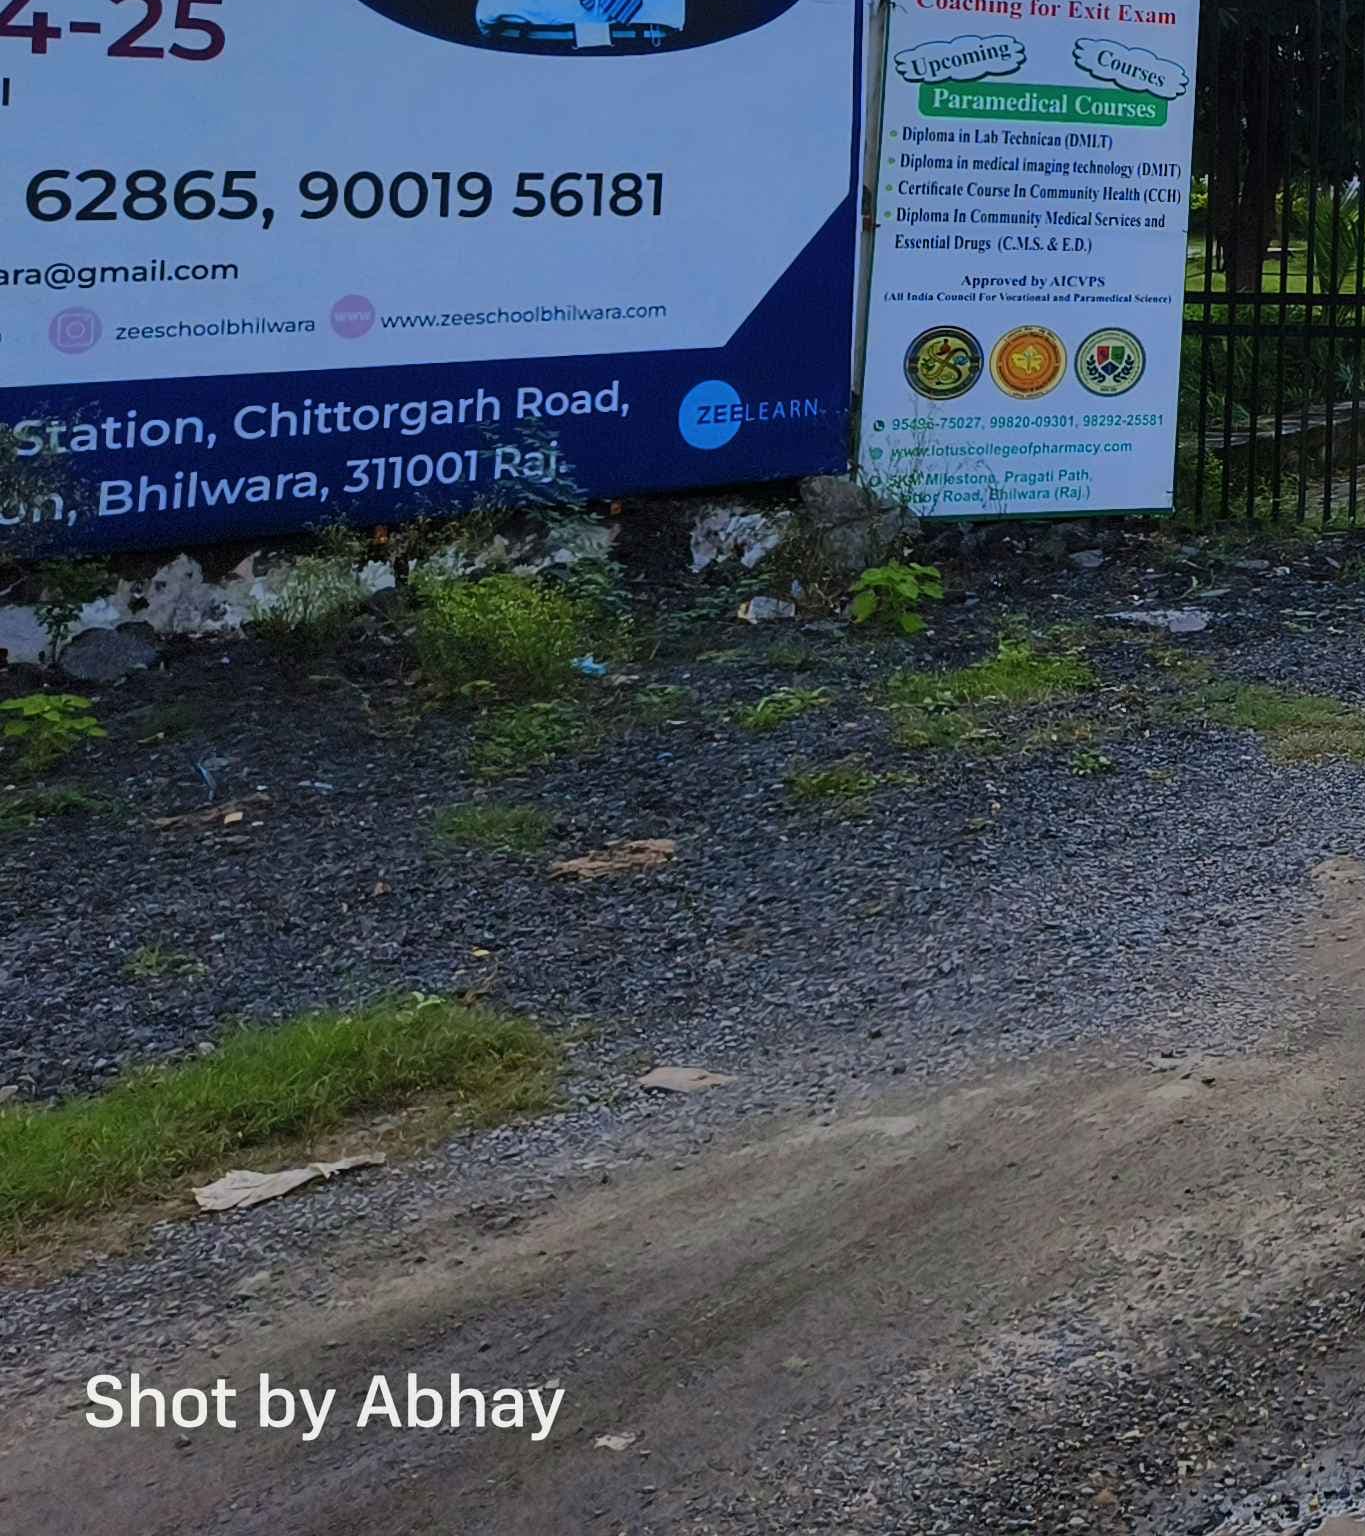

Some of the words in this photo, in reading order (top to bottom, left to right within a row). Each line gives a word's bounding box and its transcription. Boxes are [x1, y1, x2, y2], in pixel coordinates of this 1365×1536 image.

[1068, 1, 1110, 21] Exit
[1118, 4, 1177, 25] Exam
[910, 42, 1010, 78] Upcoming
[1096, 49, 1167, 89] Courses
[932, 88, 1068, 114] Paramedical
[1075, 95, 1157, 119] Courses
[902, 126, 955, 145] Diploma
[958, 128, 971, 144] in
[974, 128, 998, 145] Lab
[1002, 130, 1062, 148] Technican
[900, 153, 953, 174] Diploma
[956, 155, 969, 170] in
[972, 156, 1020, 172] medical
[1022, 158, 1070, 176] imaging
[1072, 160, 1134, 179] technology
[1137, 163, 1182, 179] (DMIT)
[26, 169, 275, 230] 62865,
[299, 170, 494, 219] 90019
[512, 172, 664, 217] 56181
[898, 180, 964, 197] Certificate
[966, 183, 1010, 198] Course
[1013, 184, 1027, 199] In
[1029, 184, 1100, 202] Community
[1102, 187, 1141, 202] Health
[1143, 189, 1182, 205] (CCH)
[896, 207, 950, 227] Diploma
[953, 208, 966, 224] In
[970, 209, 1041, 228] Community
[1045, 211, 1092, 226] Medical
[1094, 213, 1142, 228] Services
[1144, 214, 1165, 229] and
[895, 234, 950, 250] Essential
[954, 236, 992, 255] Drugs
[1047, 238, 1058, 252] &
[961, 275, 1028, 290] Approved
[1031, 276, 1047, 289] by
[1050, 276, 1106, 289] AICVPS
[907, 293, 934, 303] India
[936, 293, 976, 303] Council
[1000, 293, 1051, 304] Vocational
[1053, 294, 1071, 304] and
[1073, 294, 1132, 305] Paramedical
[116, 317, 316, 341] zeeschoolbhilwara
[380, 302, 667, 330] www.zeeschoolbhilwara.com
[13, 410, 217, 457] Station,
[234, 388, 499, 440] Chittorgarh
[516, 380, 630, 421] Road,
[99, 469, 329, 517] Bhilwara,
[343, 449, 478, 494] 311001
[494, 441, 568, 482] Raj.
[1004, 470, 1054, 486] Pragati
[1058, 469, 1093, 484] Path,
[989, 486, 1051, 501] Bhilwara
[1055, 485, 1091, 501] (Raj.)
